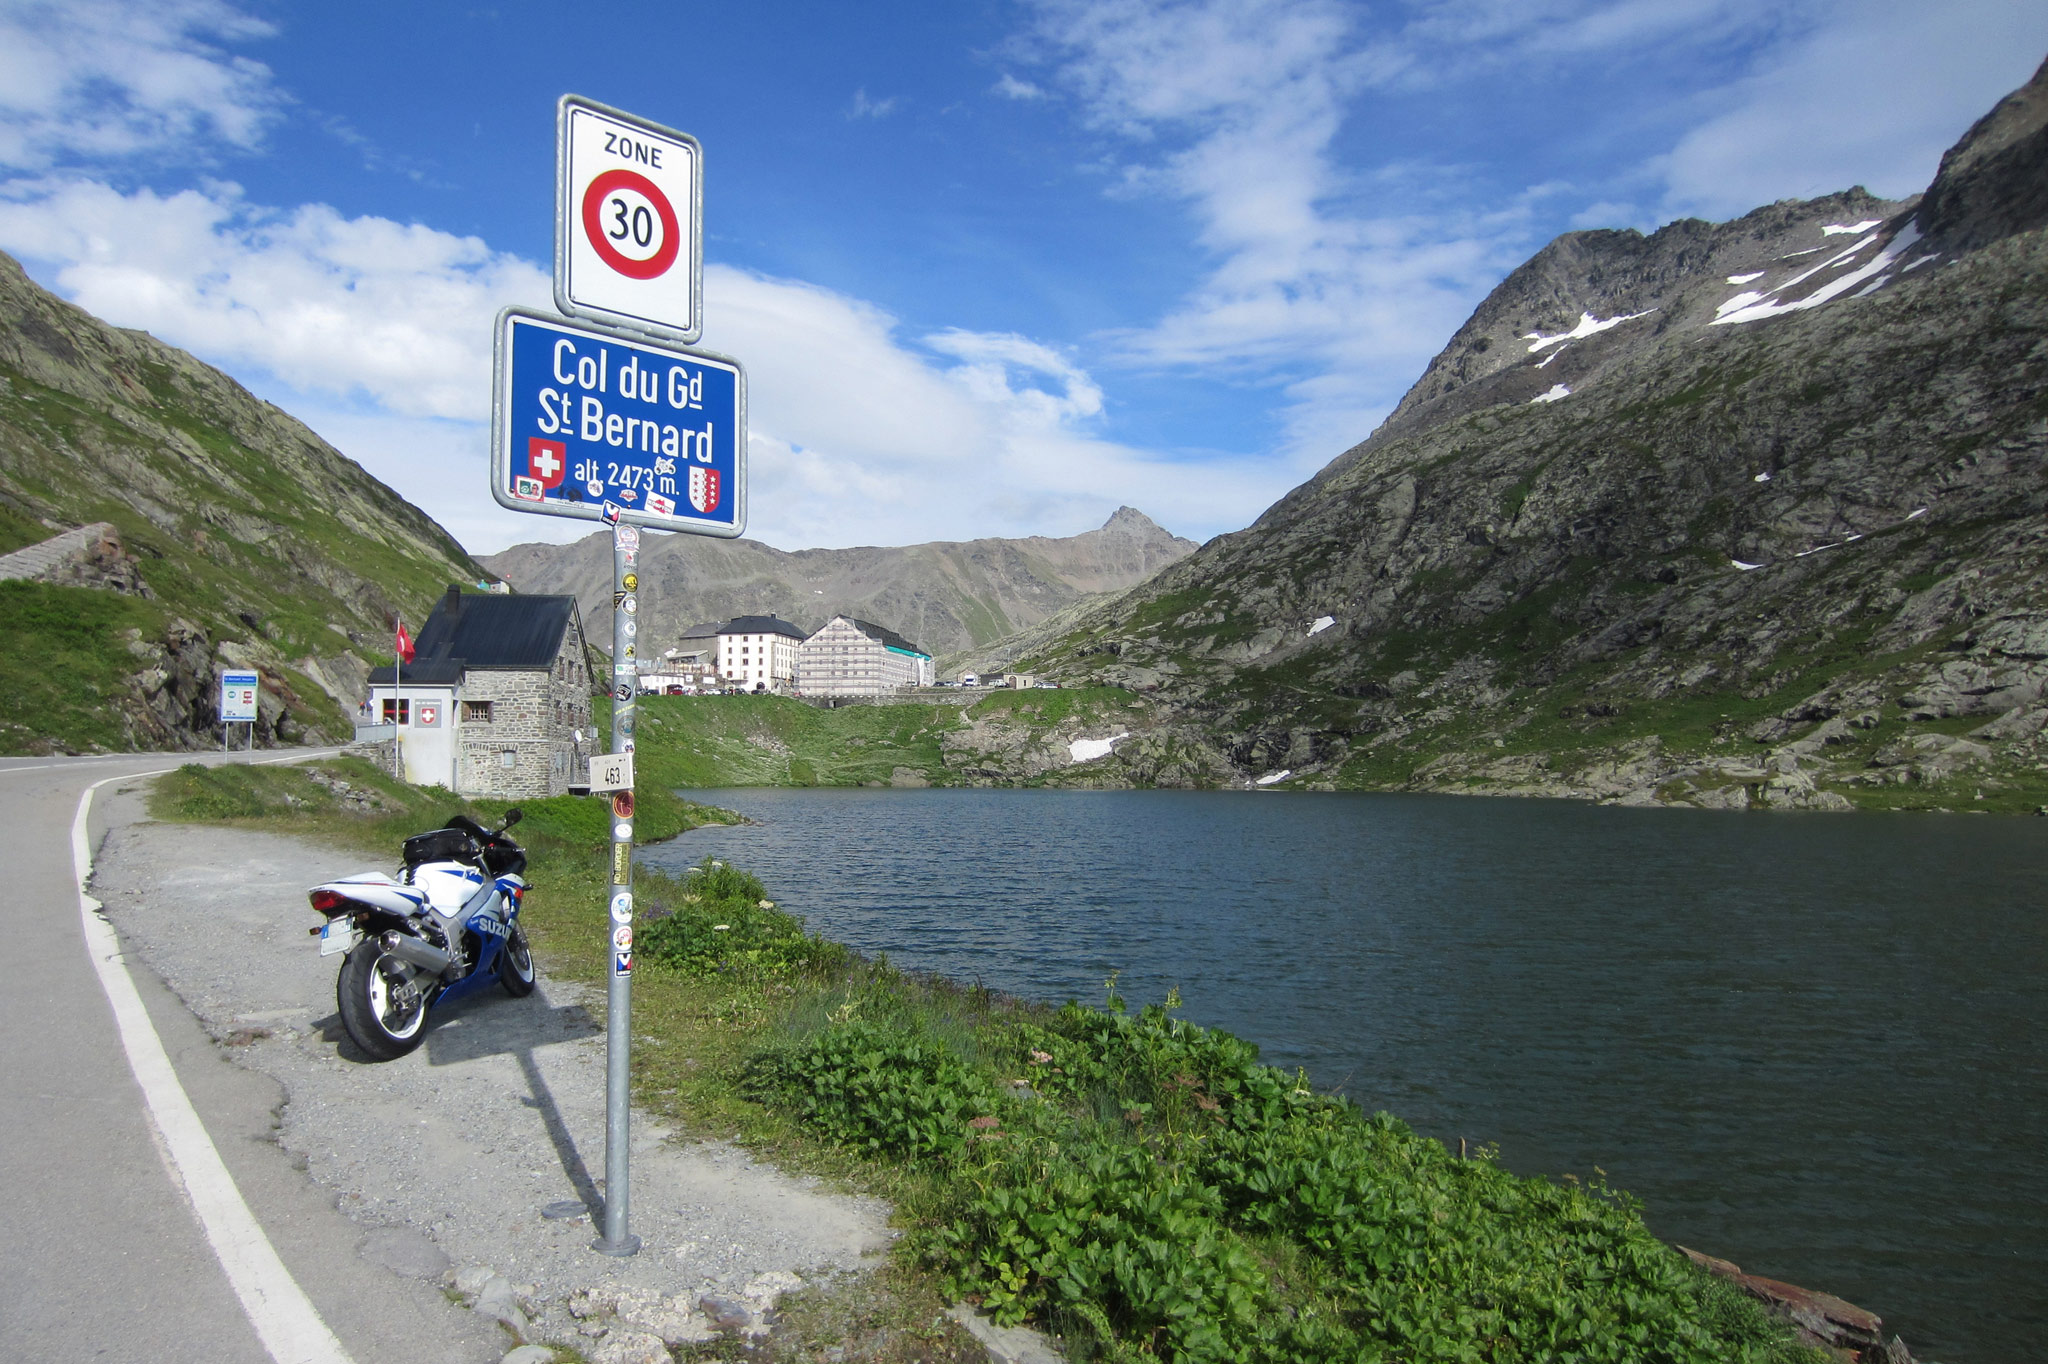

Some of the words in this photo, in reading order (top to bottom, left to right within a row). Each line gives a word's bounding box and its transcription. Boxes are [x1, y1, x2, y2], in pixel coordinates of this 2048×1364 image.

[604, 131, 663, 170] ZONE
[609, 198, 653, 248] 30
[553, 338, 608, 393] Col
[619, 355, 659, 404] du
[667, 365, 703, 411] Gd
[537, 387, 575, 435] St
[580, 395, 713, 464] Bernard
[607, 462, 655, 492] 2473
[660, 475, 680, 496] m.
[604, 766, 621, 785] 463
